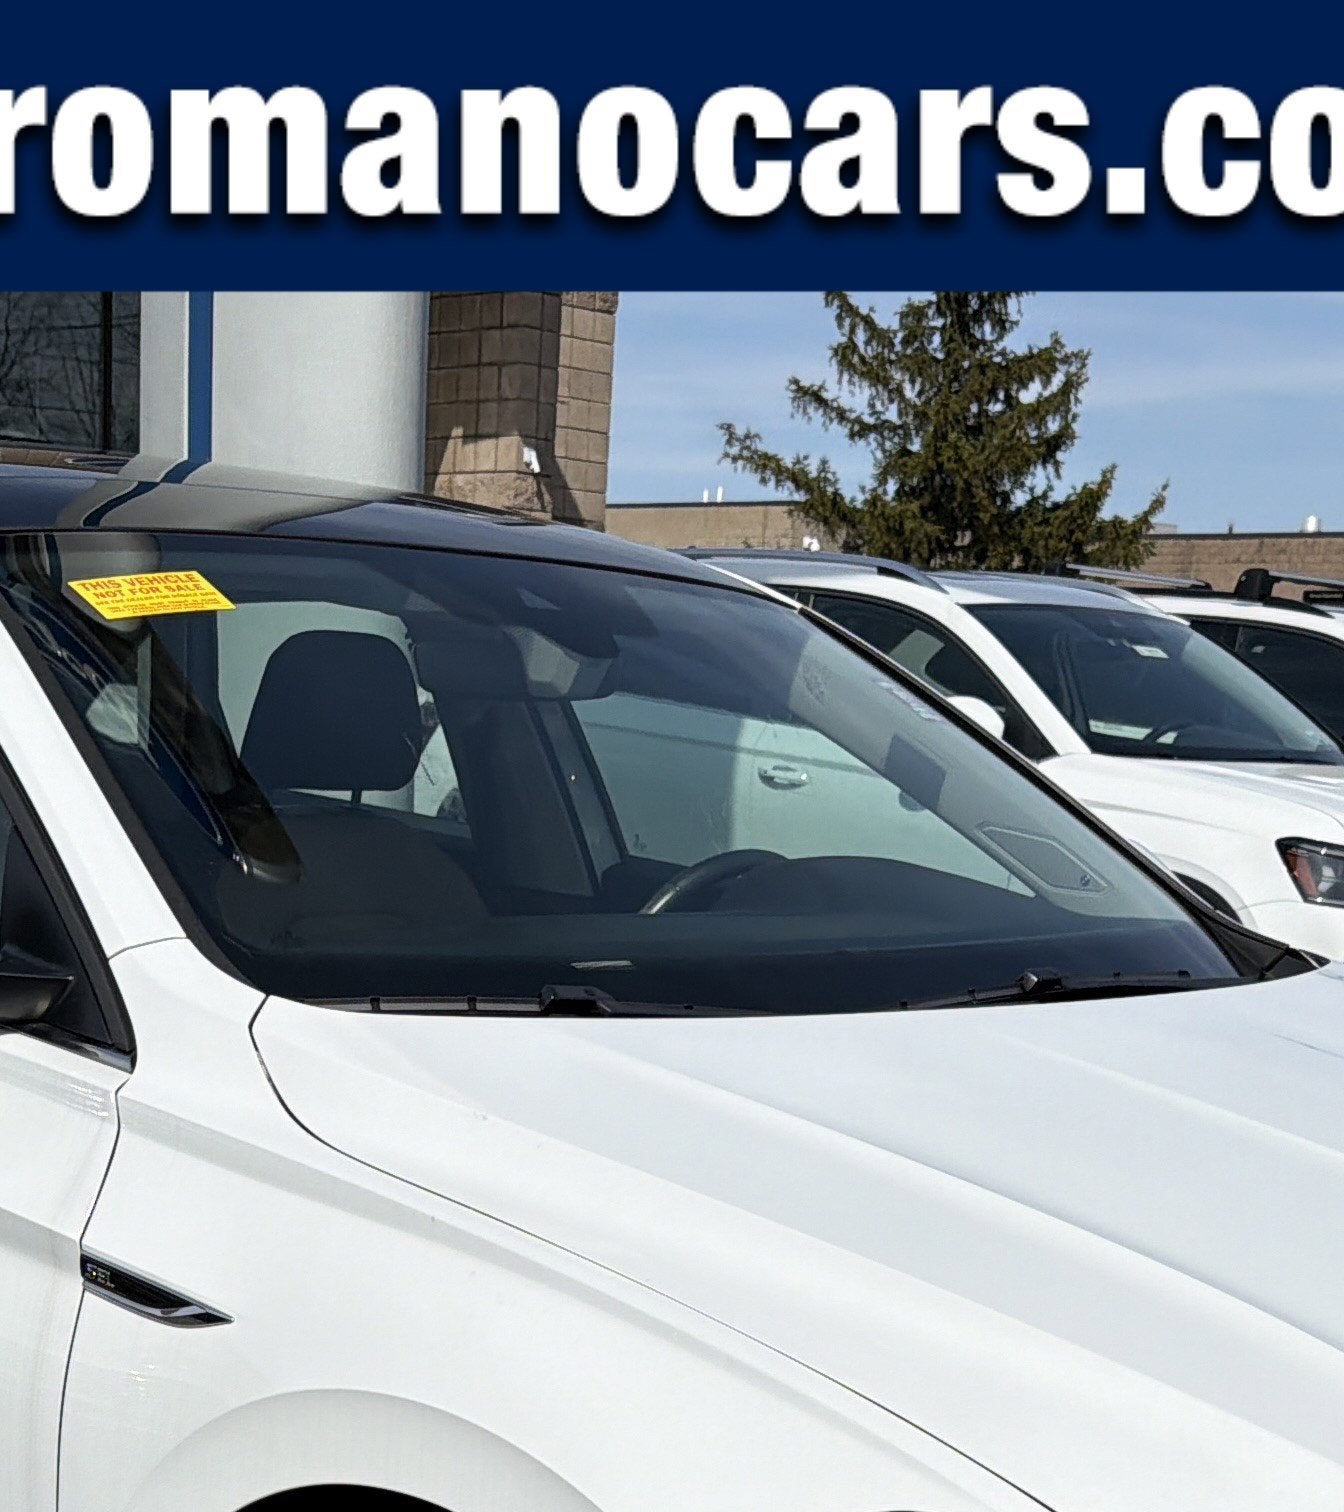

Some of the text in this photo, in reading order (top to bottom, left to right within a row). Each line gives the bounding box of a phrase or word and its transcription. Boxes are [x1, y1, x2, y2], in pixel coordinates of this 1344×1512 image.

[78, 573, 200, 593] THIS VEHICLE
[93, 587, 125, 600] NOT
[128, 585, 163, 596] FOR
[164, 583, 206, 593] SALE
